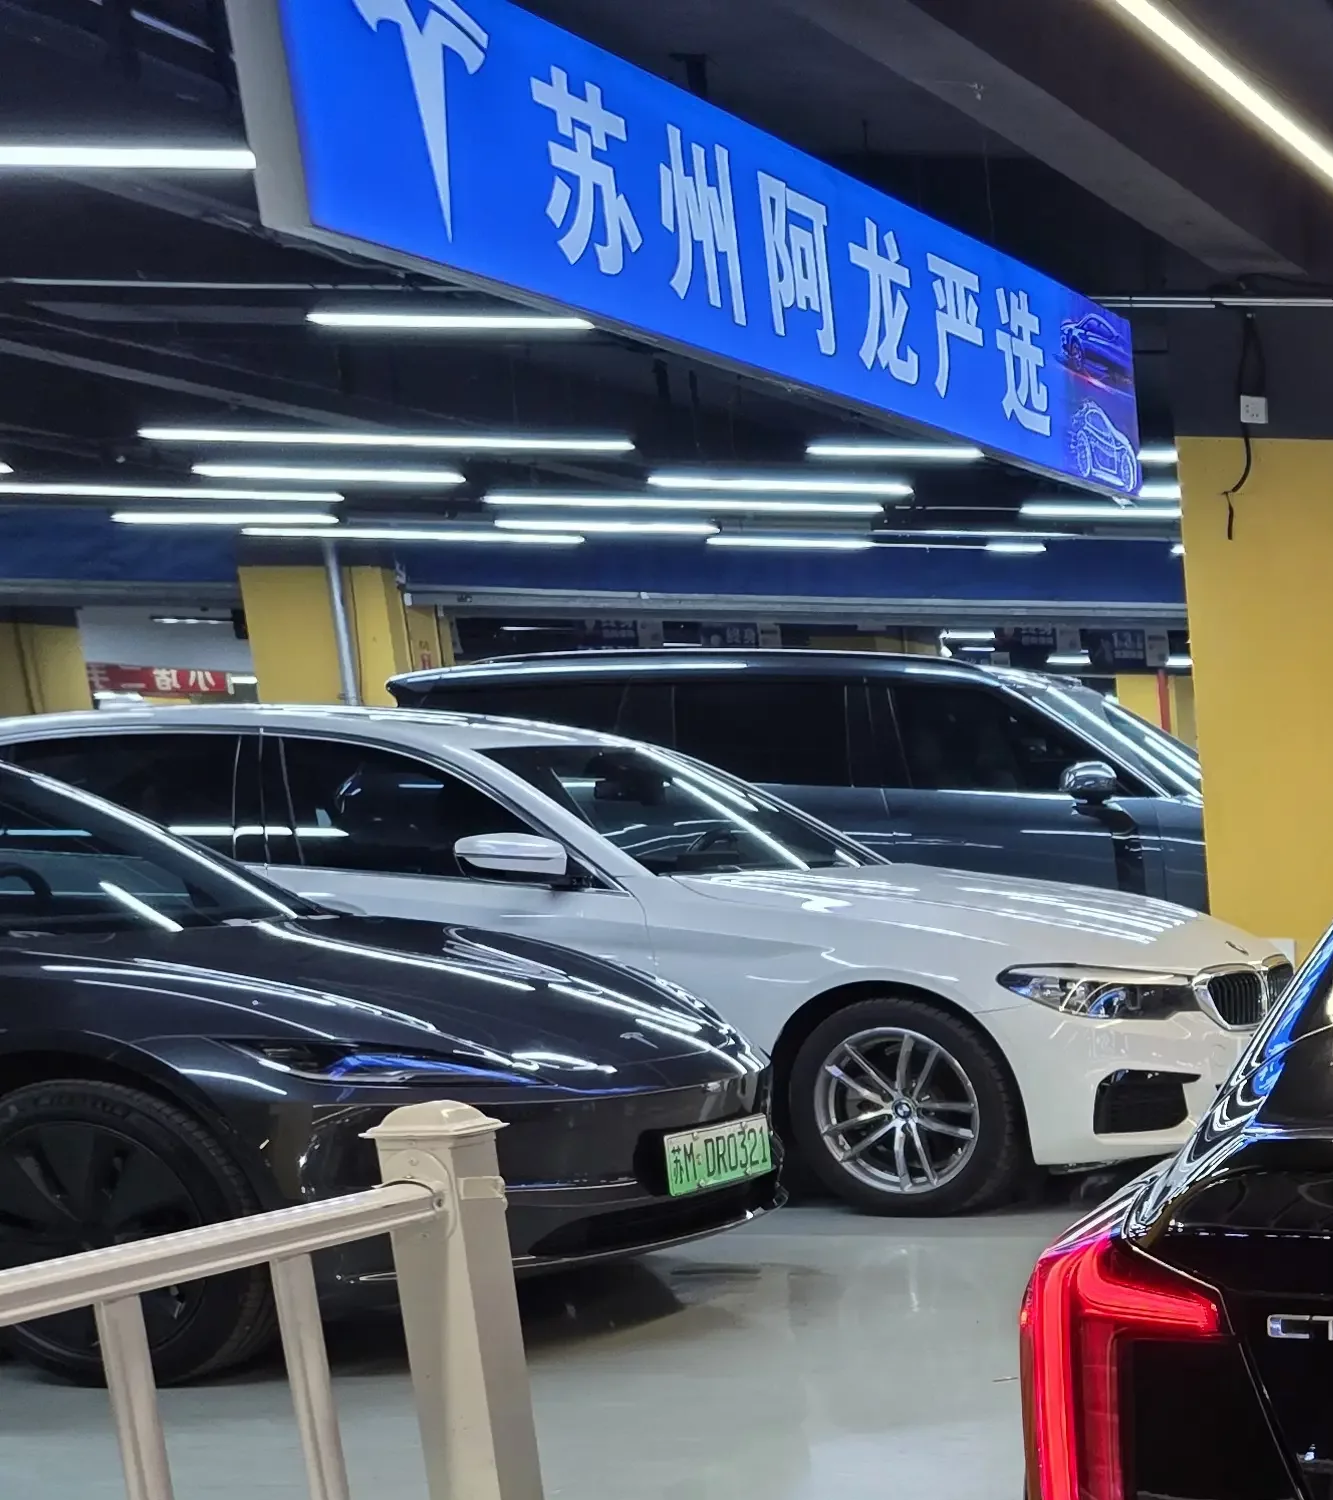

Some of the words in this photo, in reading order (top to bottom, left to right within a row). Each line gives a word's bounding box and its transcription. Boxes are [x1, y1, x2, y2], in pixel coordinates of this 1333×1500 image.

[531, 66, 1050, 436] 苏州阿龙严选
